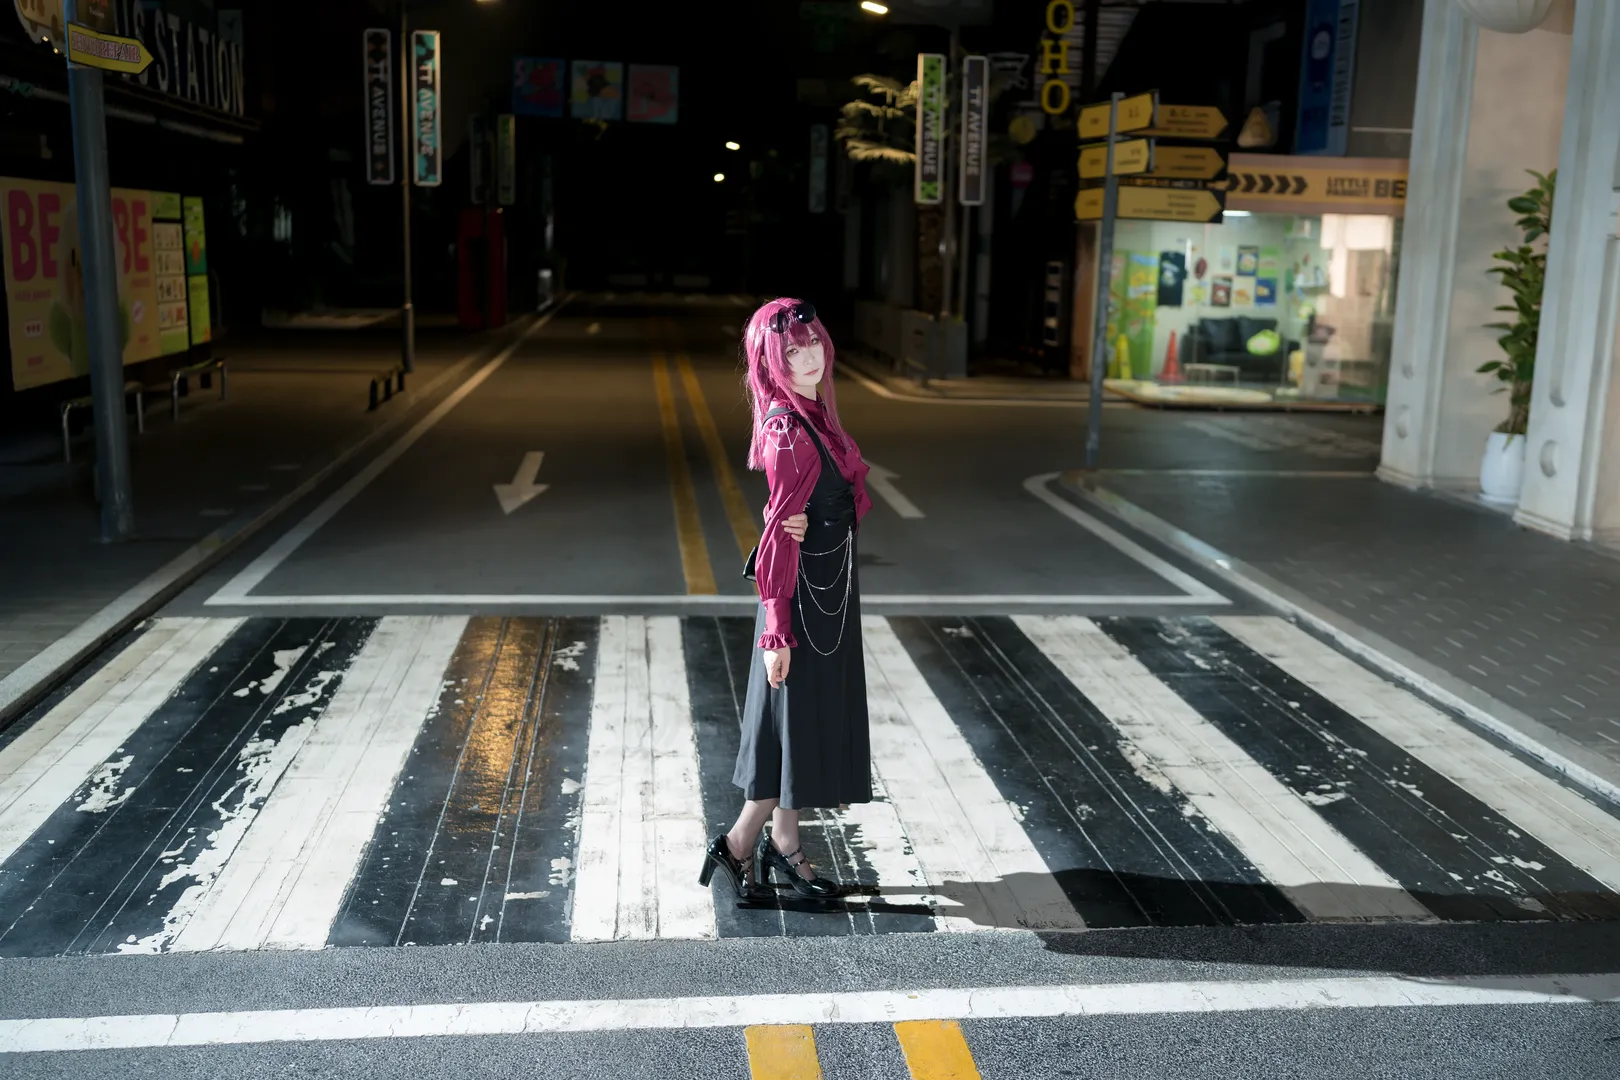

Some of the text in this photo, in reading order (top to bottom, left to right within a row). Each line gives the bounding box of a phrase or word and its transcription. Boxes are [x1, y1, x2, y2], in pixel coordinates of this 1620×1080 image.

[154, 7, 245, 117] STATION
[371, 85, 388, 155] AVENUE
[418, 62, 434, 157] TT AVENUE
[923, 110, 938, 175] AVENUE
[966, 86, 983, 176] TT AVENUE
[1326, 176, 1370, 188] LITTLE
[8, 190, 61, 281] BE
